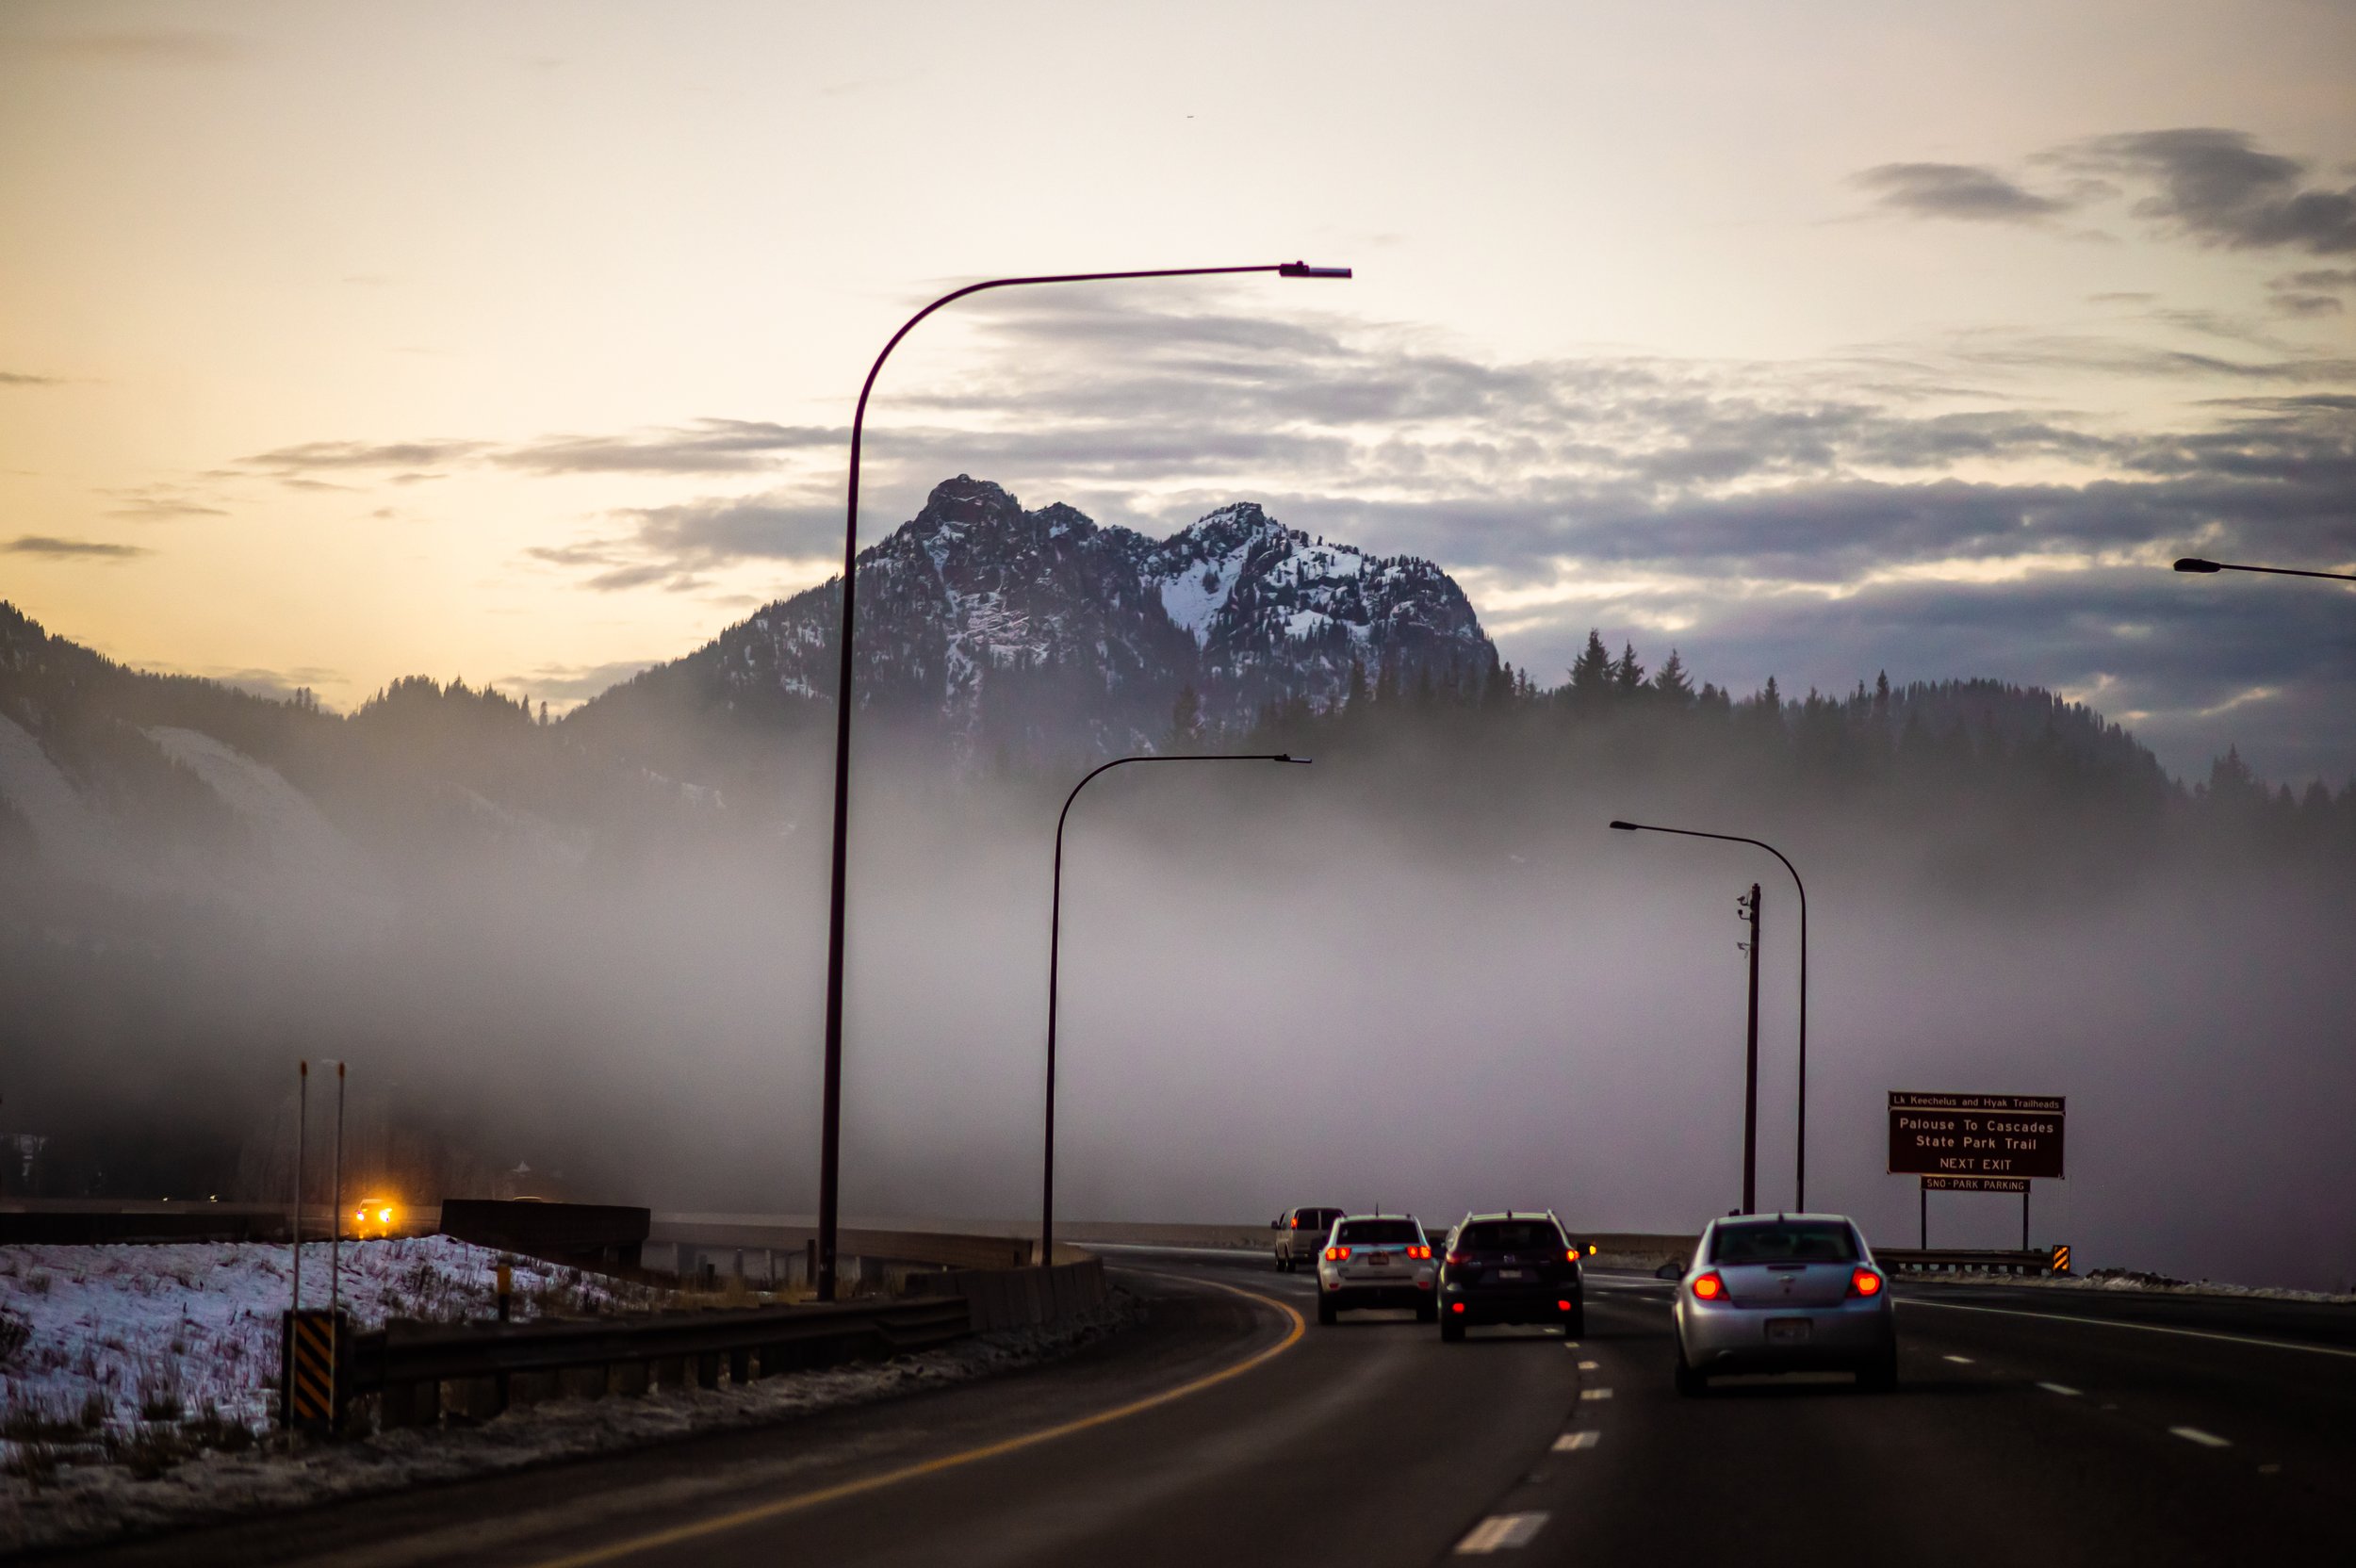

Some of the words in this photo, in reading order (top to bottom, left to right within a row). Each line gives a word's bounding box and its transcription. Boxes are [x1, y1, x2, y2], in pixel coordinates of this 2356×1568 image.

[1894, 1096, 1906, 1104] Lk
[1910, 1097, 1956, 1106] Keechelus
[1984, 1099, 2007, 1108] Hyak
[2014, 1100, 2059, 1109] Trailheads
[1900, 1118, 1955, 1130] Palouse
[1964, 1119, 1977, 1131] To
[1988, 1120, 2053, 1133] Cascades
[1917, 1135, 1955, 1147] State
[1964, 1137, 1995, 1149] Park
[2005, 1138, 2037, 1150] Trail
[1940, 1158, 1974, 1168] NEXT
[1984, 1159, 2012, 1170] EXIT
[1984, 1181, 2023, 1190] PARKING
